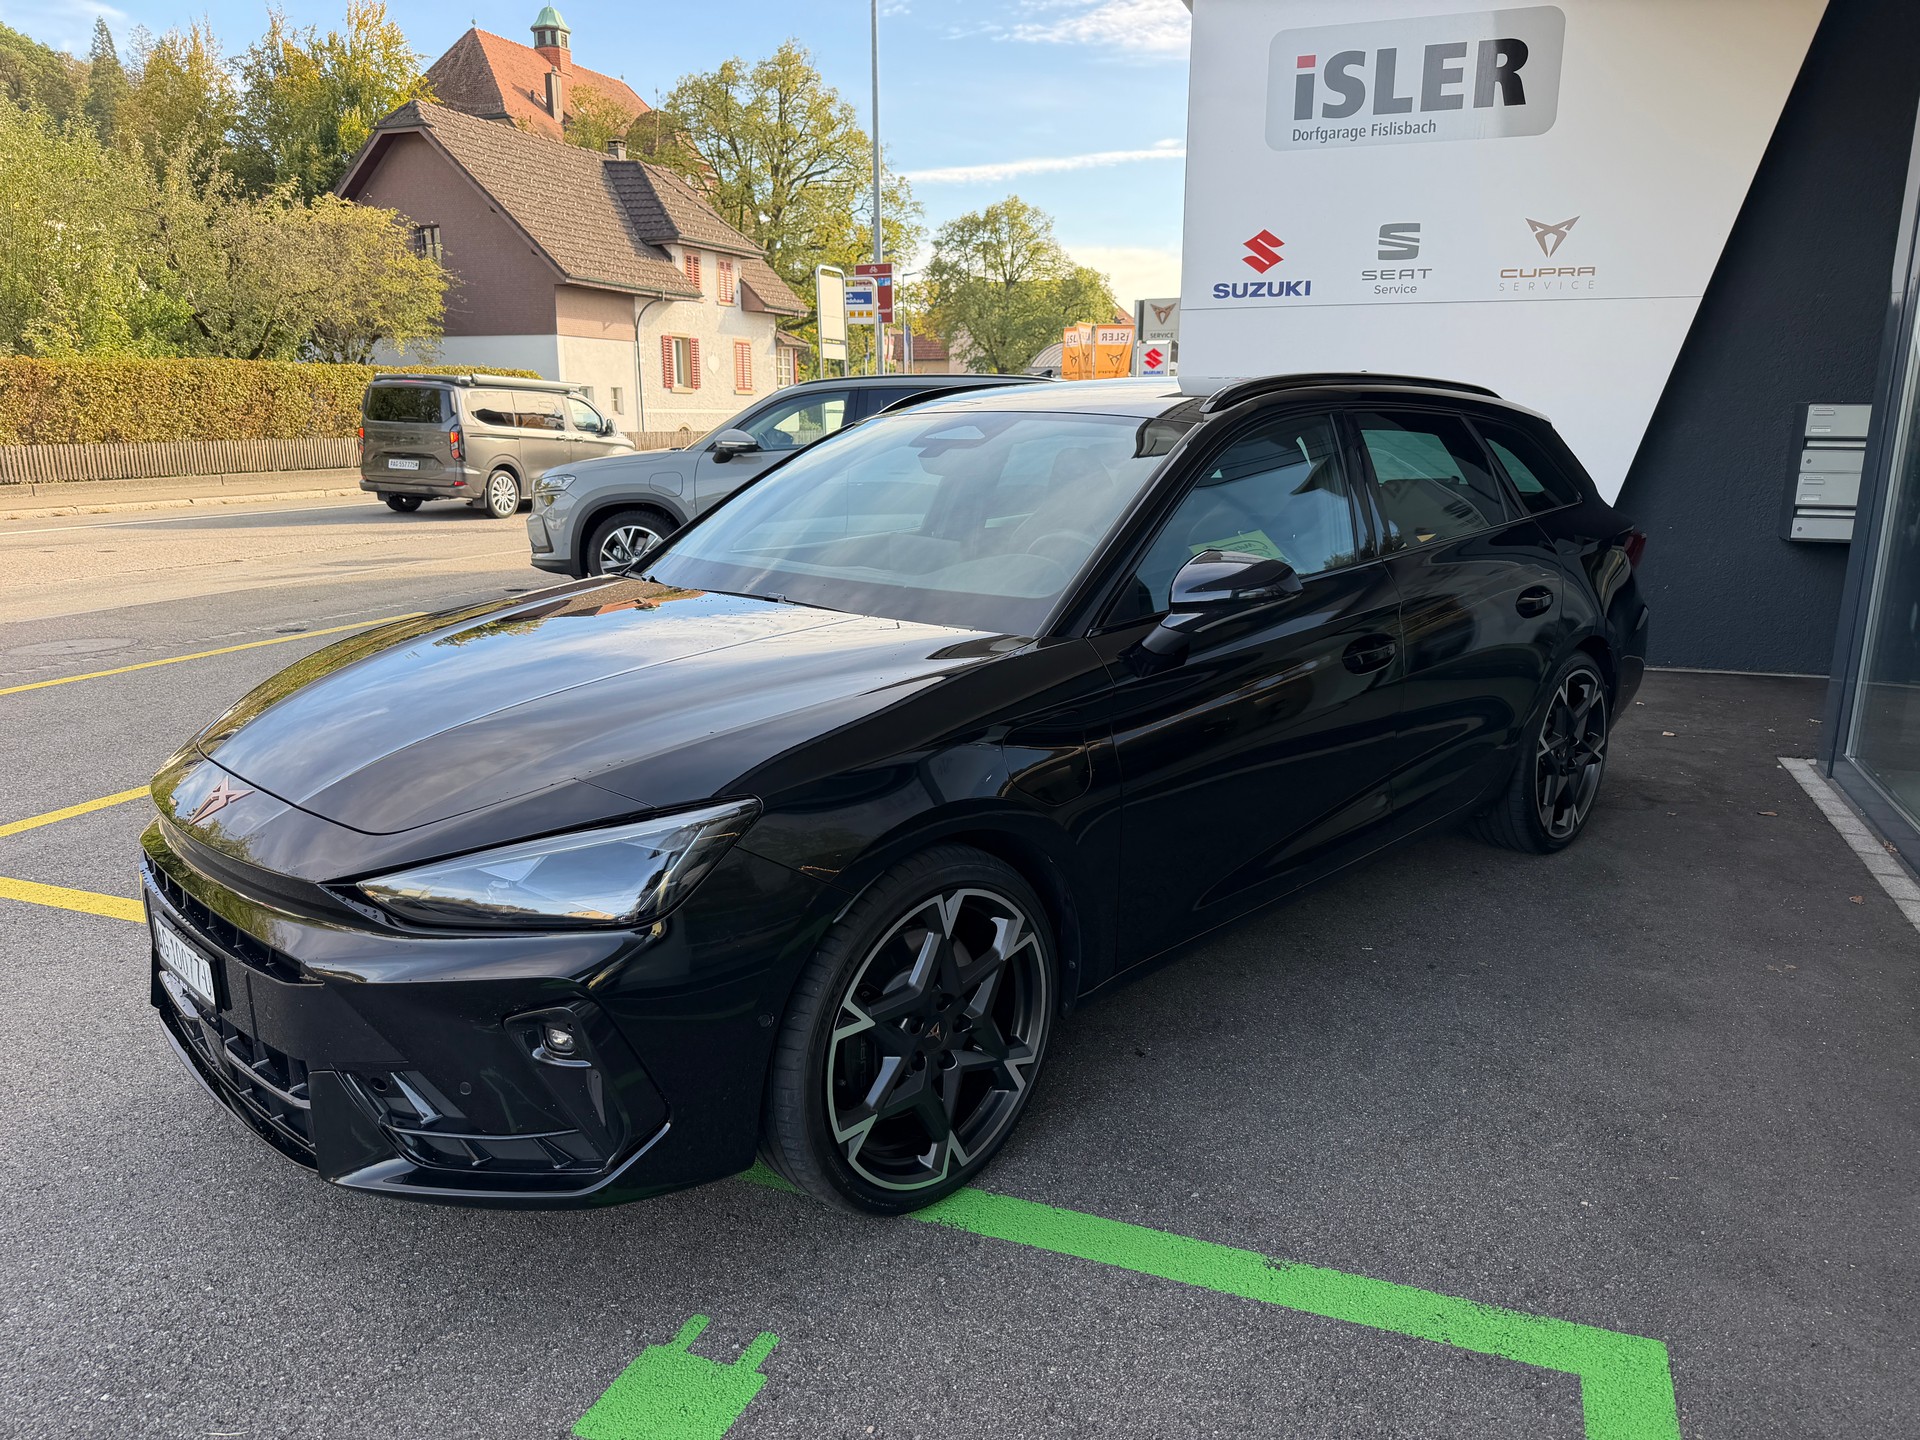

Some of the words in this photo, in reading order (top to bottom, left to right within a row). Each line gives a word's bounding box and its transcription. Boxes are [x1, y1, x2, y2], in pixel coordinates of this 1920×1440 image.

[1293, 38, 1529, 120] iSLER
[1292, 126, 1367, 144] Dorfgarage
[1371, 119, 1437, 138] Fislisbach
[1361, 268, 1433, 281] SEAT
[1500, 266, 1596, 279] CUPRA
[1212, 280, 1312, 299] SUZUKI
[1373, 284, 1418, 295] Service
[1499, 279, 1595, 292] SERVICE
